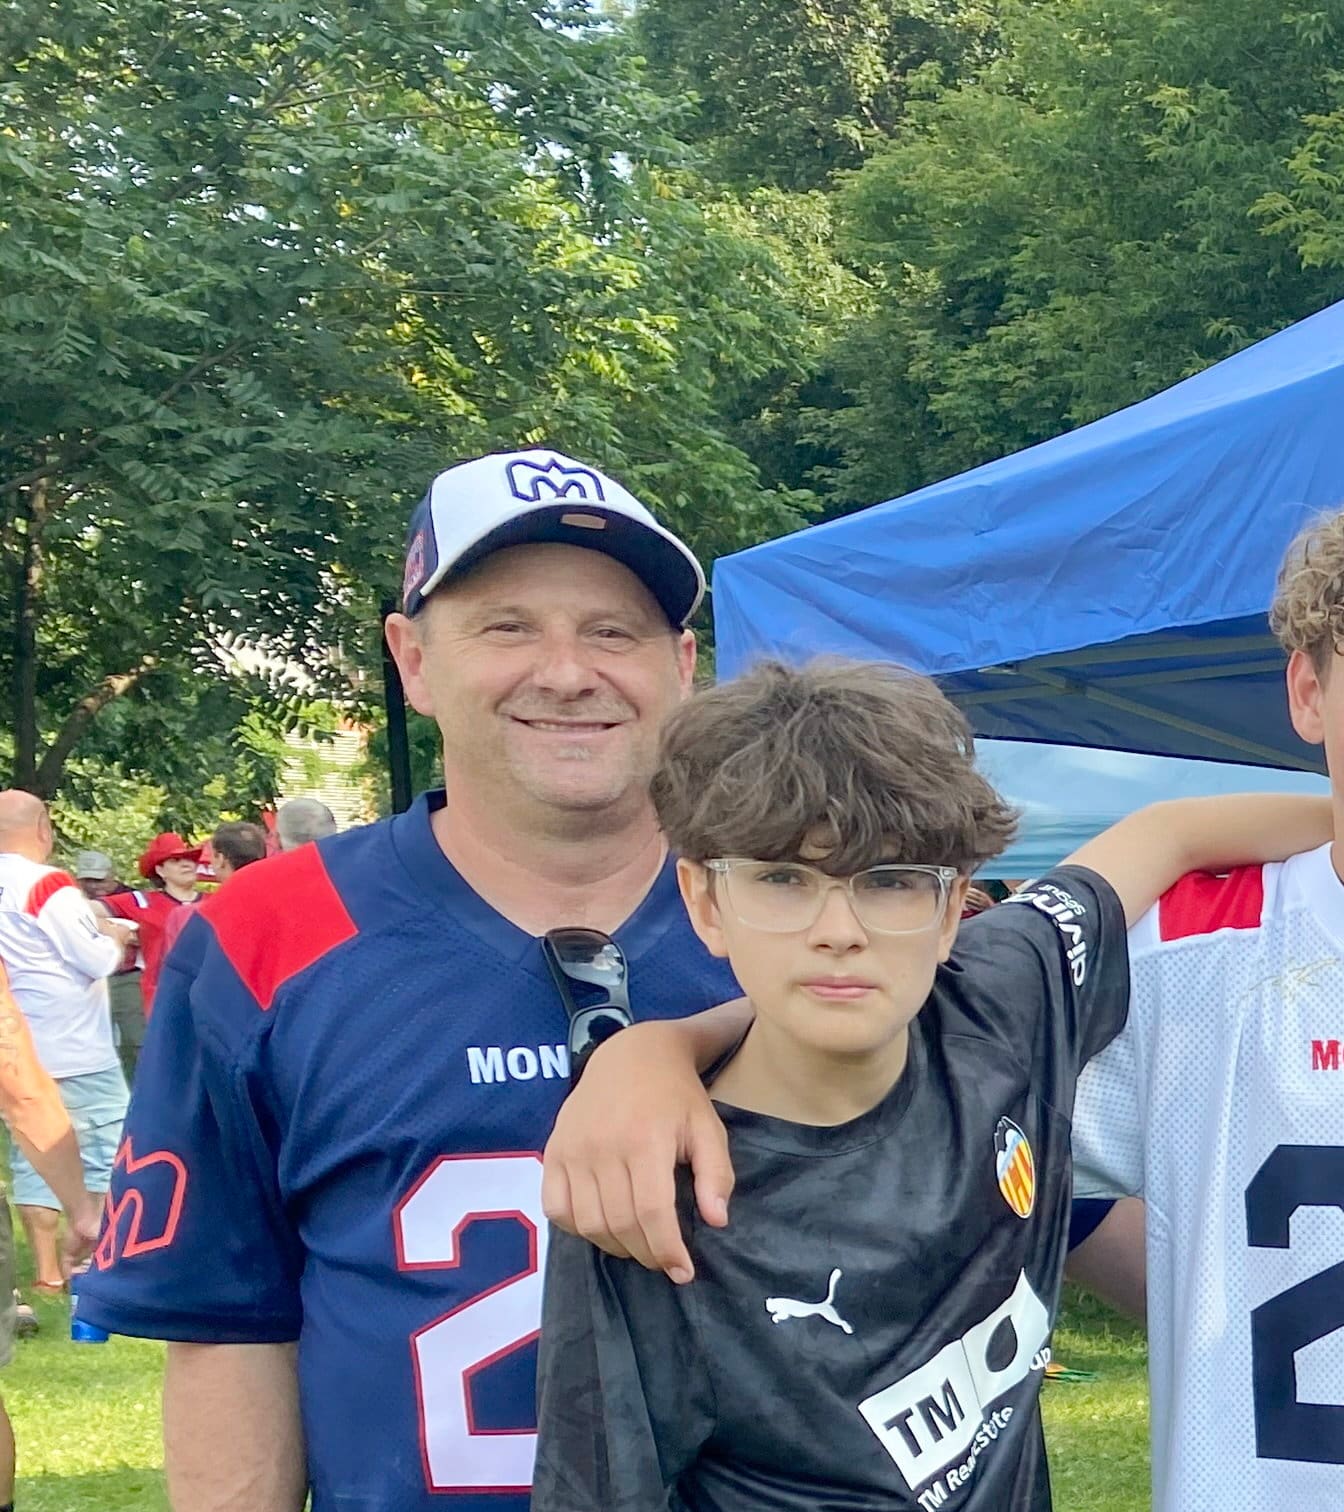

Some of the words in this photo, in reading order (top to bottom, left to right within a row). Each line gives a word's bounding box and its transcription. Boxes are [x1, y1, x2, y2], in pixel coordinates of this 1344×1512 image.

[466, 1044, 571, 1084] MON
[397, 1151, 547, 1494] 2
[882, 1377, 966, 1458] TM
